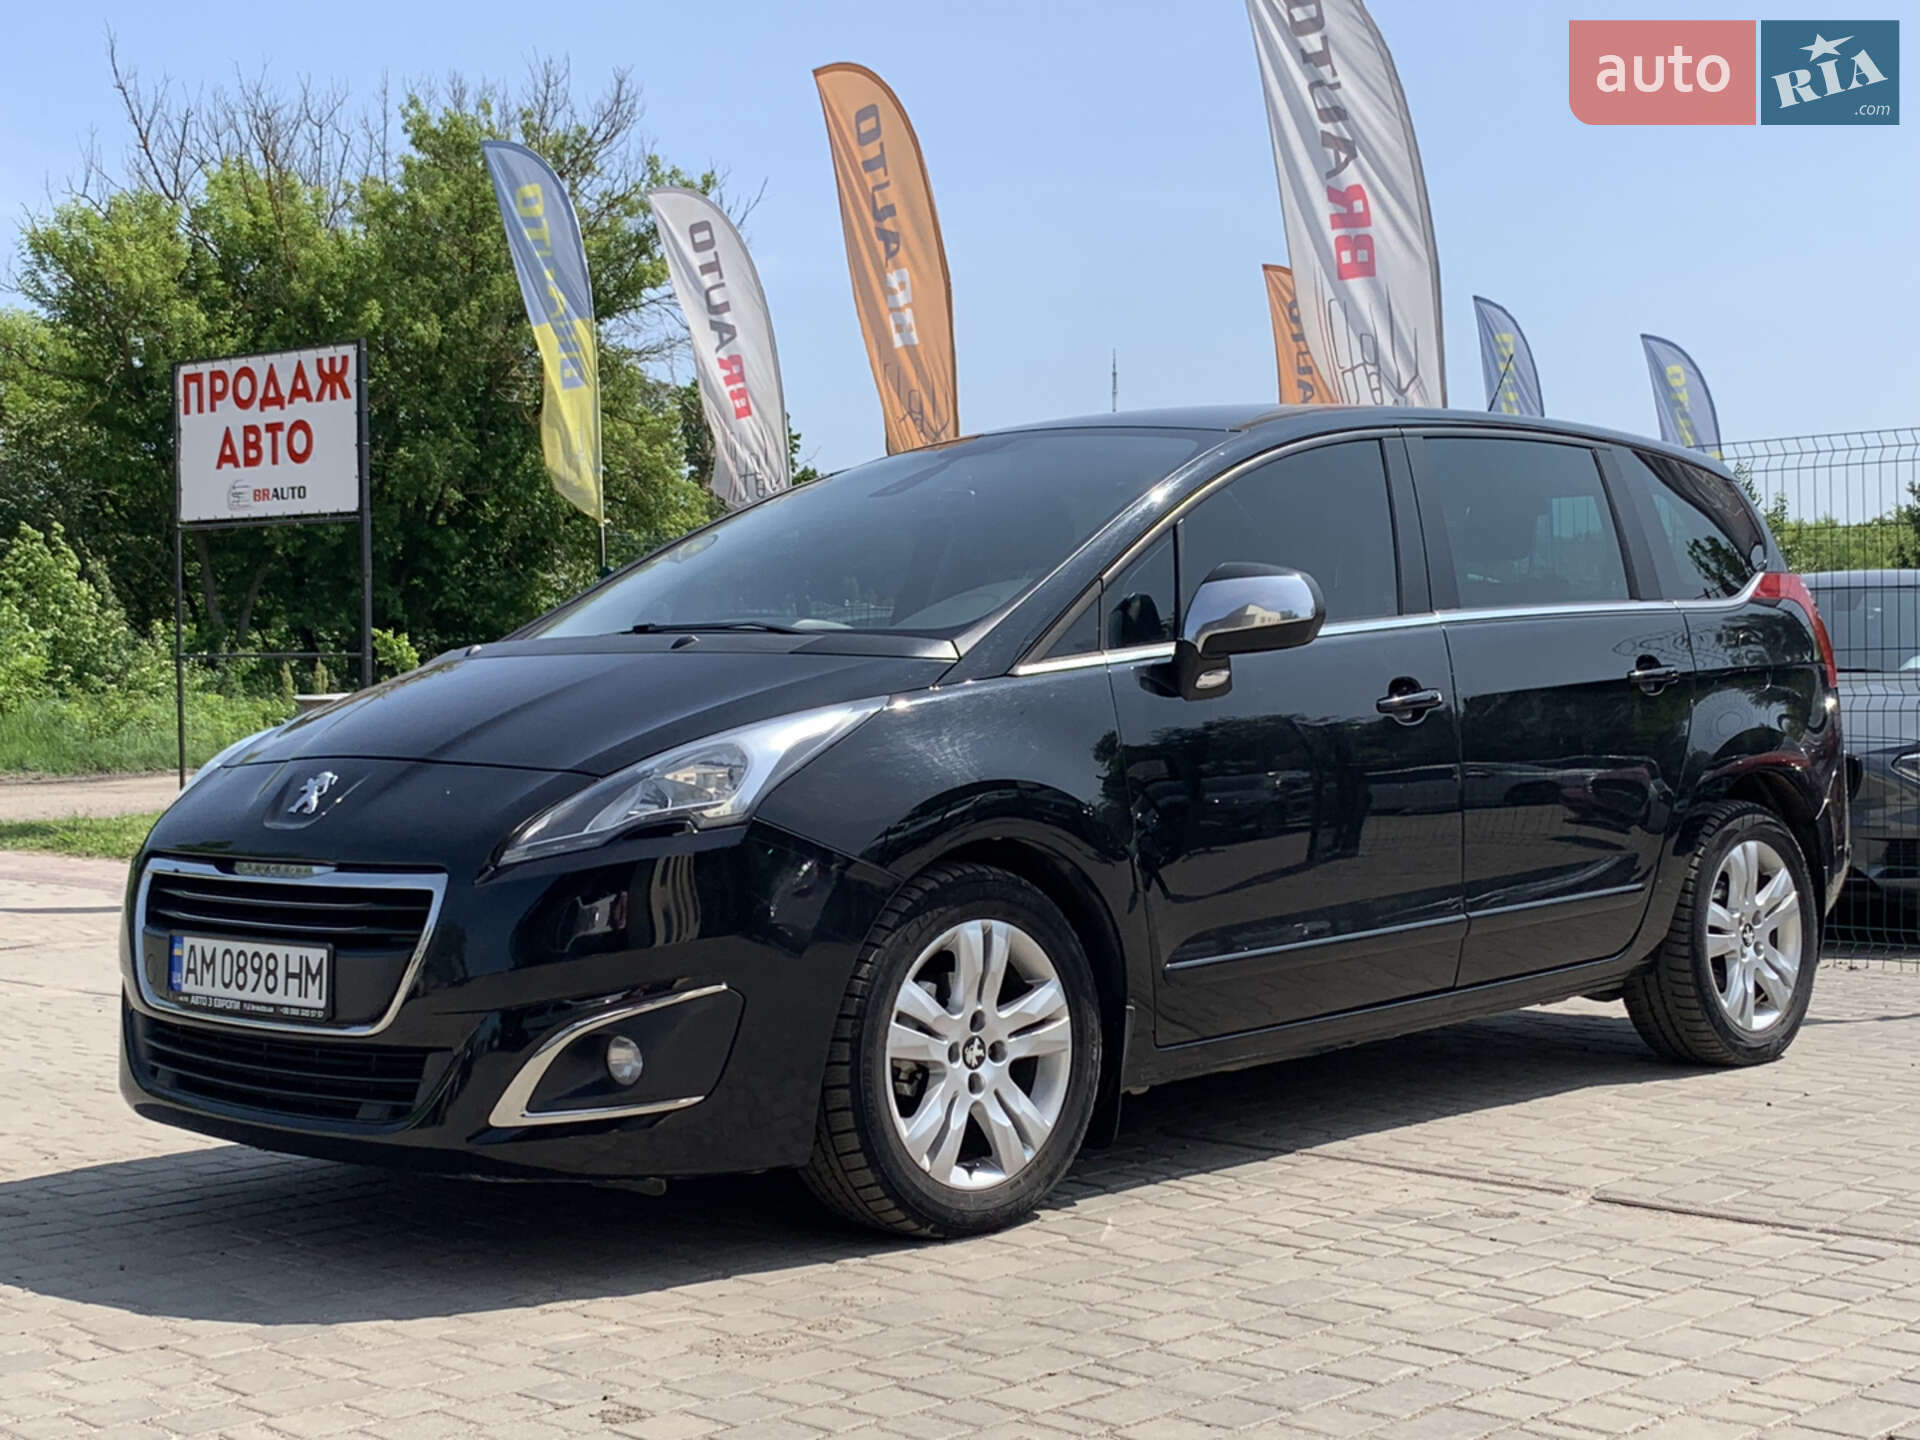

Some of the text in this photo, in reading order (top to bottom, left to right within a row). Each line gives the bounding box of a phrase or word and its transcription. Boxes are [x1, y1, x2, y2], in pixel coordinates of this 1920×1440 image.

[183, 355, 352, 415] ПРОДАЖ
[216, 419, 314, 470] АВТО
[253, 485, 307, 502] BRAUTO
